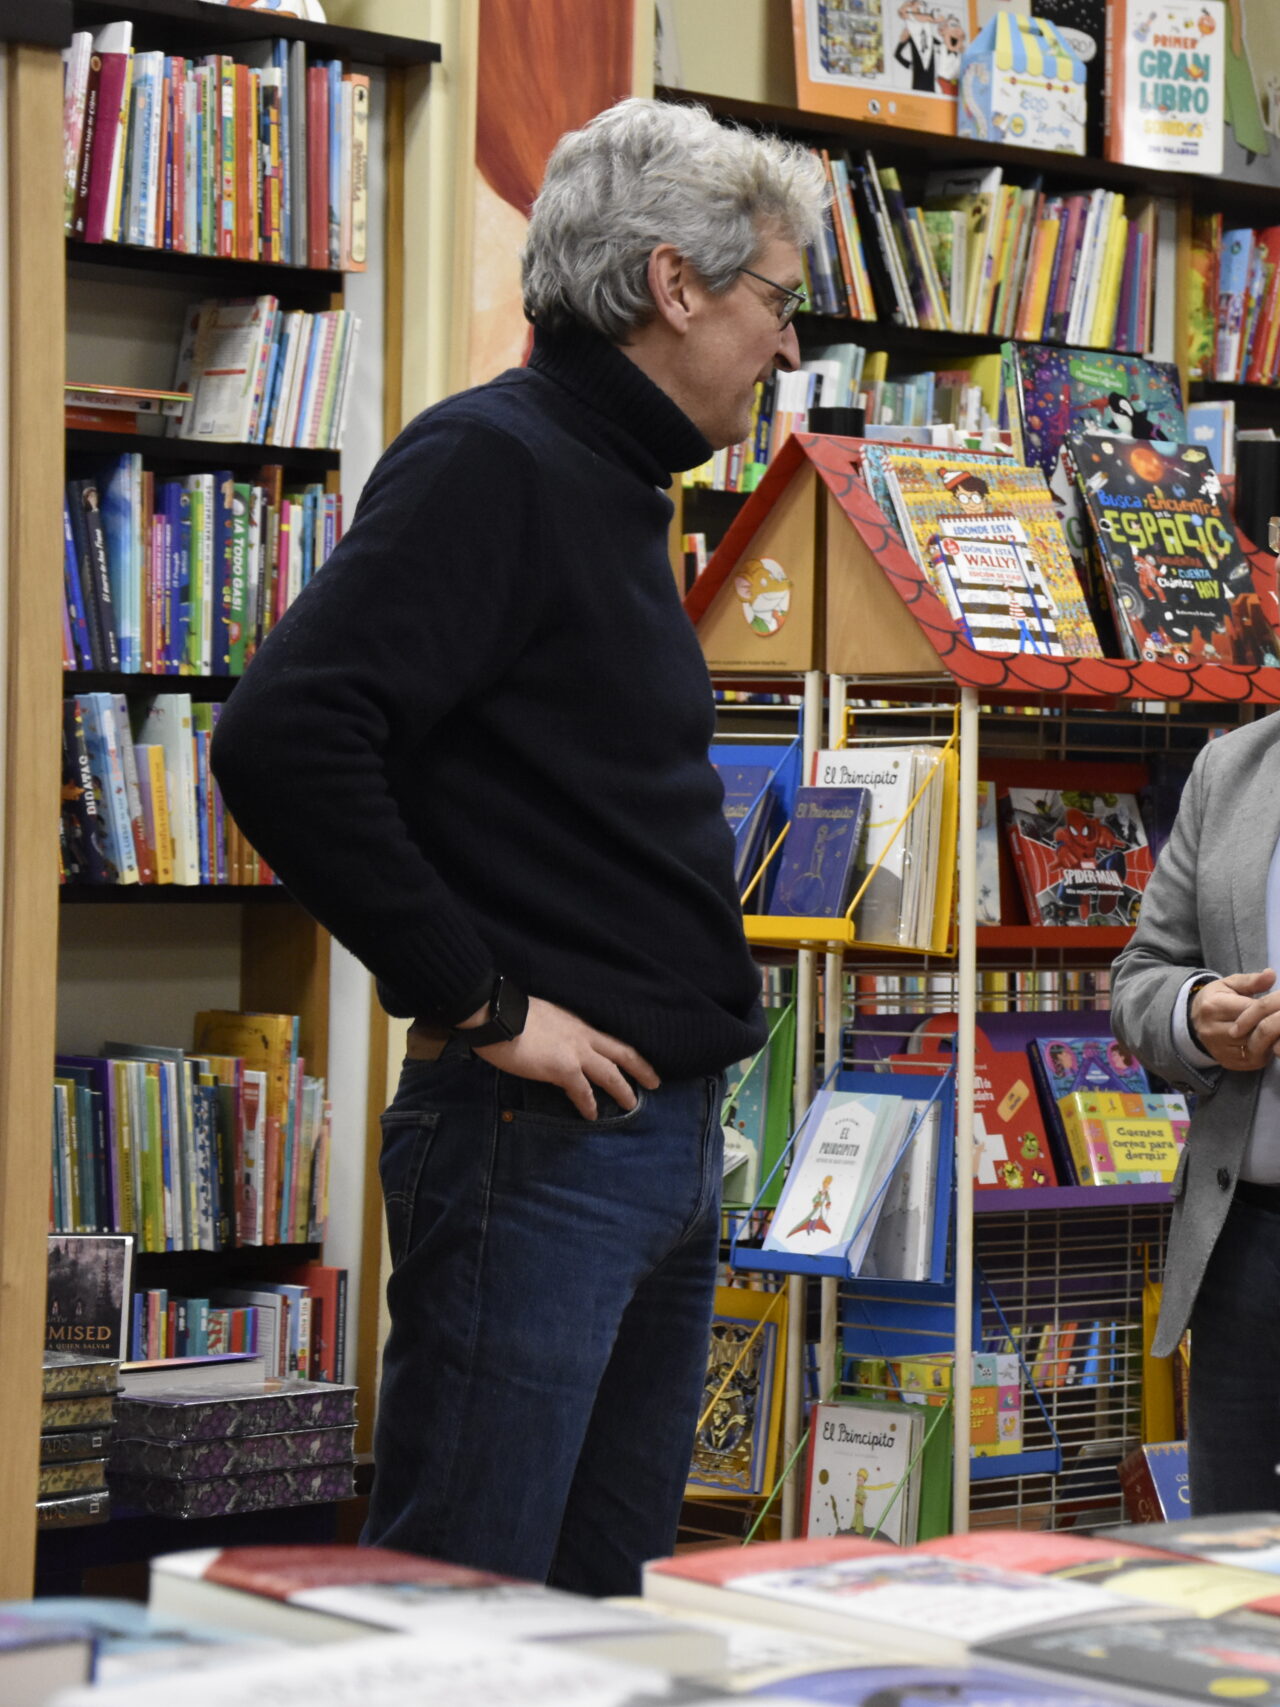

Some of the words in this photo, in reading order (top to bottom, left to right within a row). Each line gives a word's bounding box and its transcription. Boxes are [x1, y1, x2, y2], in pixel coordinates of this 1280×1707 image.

[1153, 34, 1198, 50] PRIMER
[1138, 49, 1211, 83] GRAN
[1139, 81, 1210, 114] LIBRO
[1103, 509, 1232, 556] ESPACIO
[232, 538, 246, 576] TODO
[964, 553, 1017, 569] WALLY?
[231, 577, 246, 612] GAS!
[1194, 580, 1220, 599] HAY
[824, 766, 836, 785] El
[840, 765, 898, 789] Principito
[797, 802, 808, 818] El
[809, 803, 855, 820] Principito
[1063, 869, 1123, 888] SPIDER-MAN
[840, 1127, 850, 1140] EL
[1116, 1127, 1164, 1138] Cuentos
[818, 1142, 860, 1157] PRINCIPITO
[1112, 1140, 1146, 1151] cortos
[1149, 1141, 1175, 1153] para
[1125, 1151, 1168, 1162] dormir
[48, 1325, 112, 1341] MISED
[823, 1421, 835, 1441] El
[837, 1423, 896, 1450] Principito
